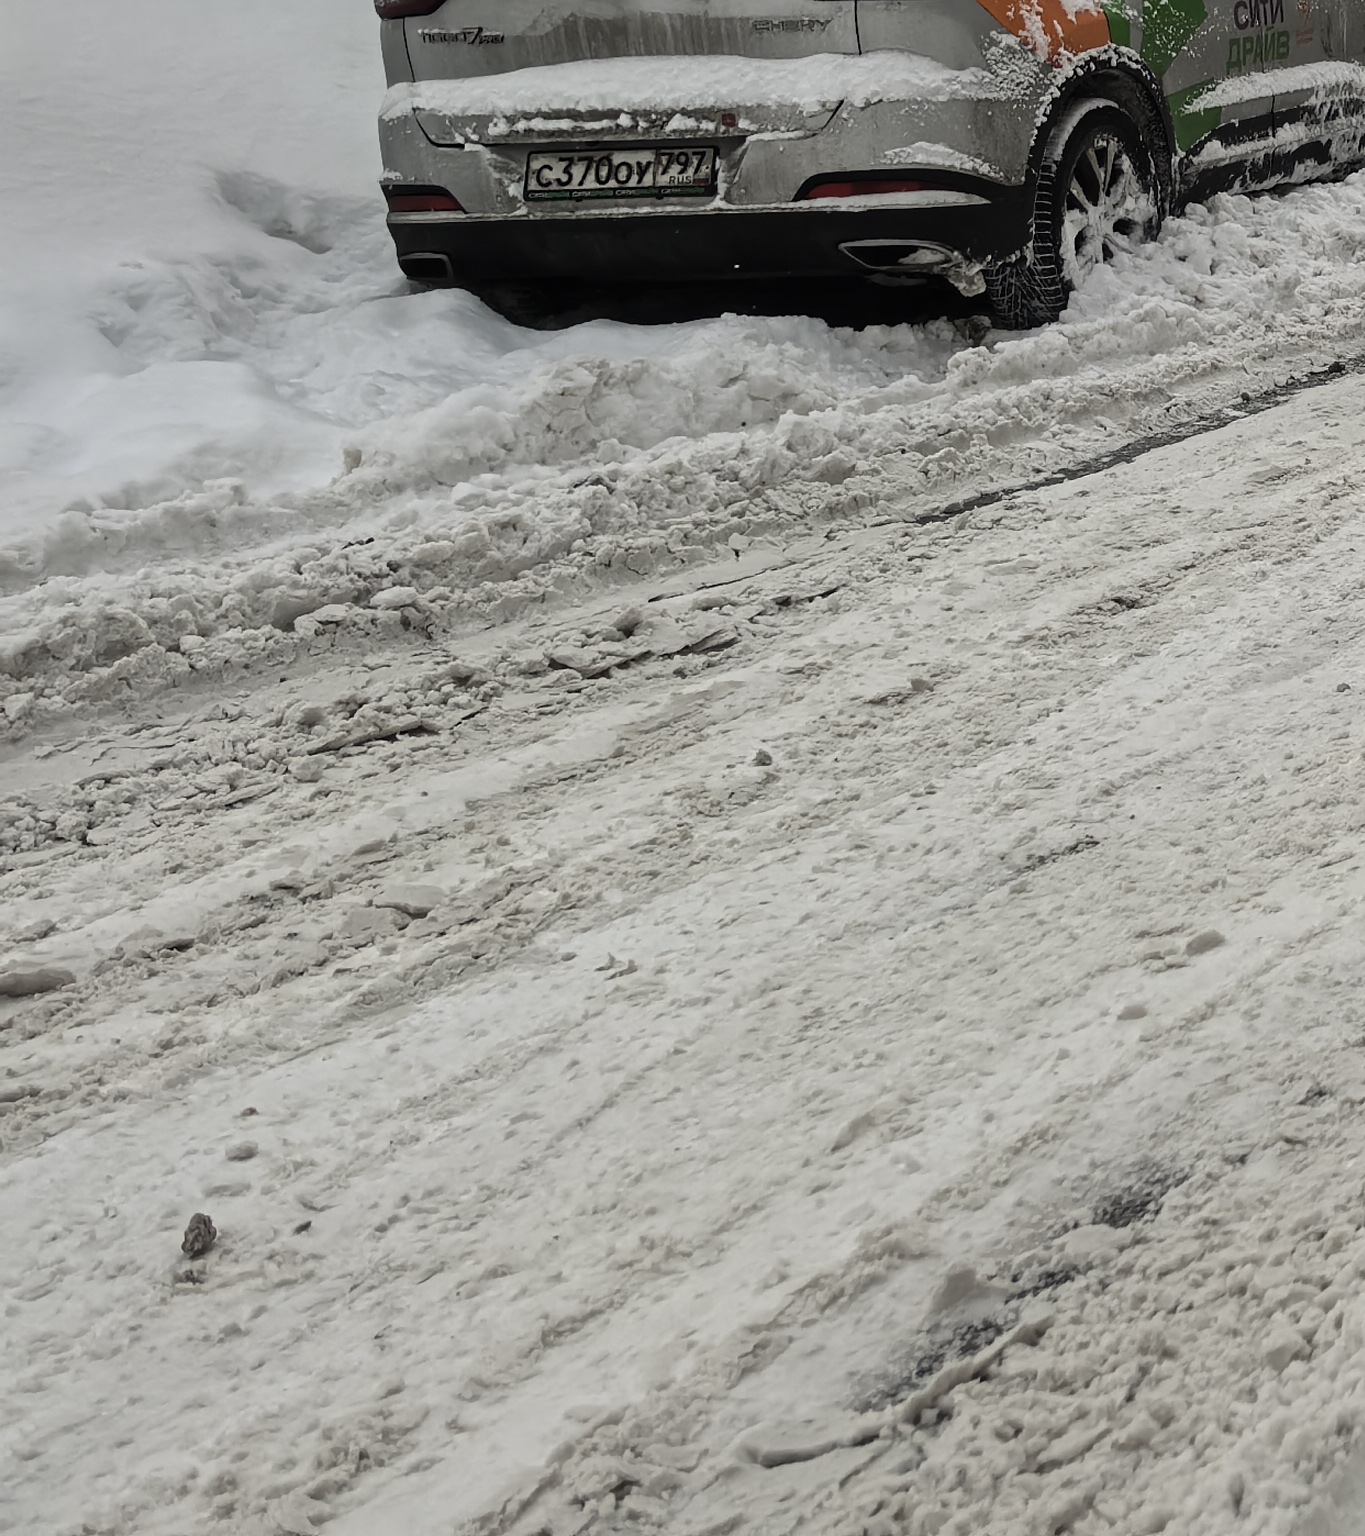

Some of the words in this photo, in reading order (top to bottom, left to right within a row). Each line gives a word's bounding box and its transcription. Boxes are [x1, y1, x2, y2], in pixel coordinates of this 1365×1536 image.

[752, 18, 834, 32] CHERY
[1226, 25, 1290, 76] ДРАЙВ
[659, 150, 707, 176] 797
[668, 174, 693, 185] RUS
